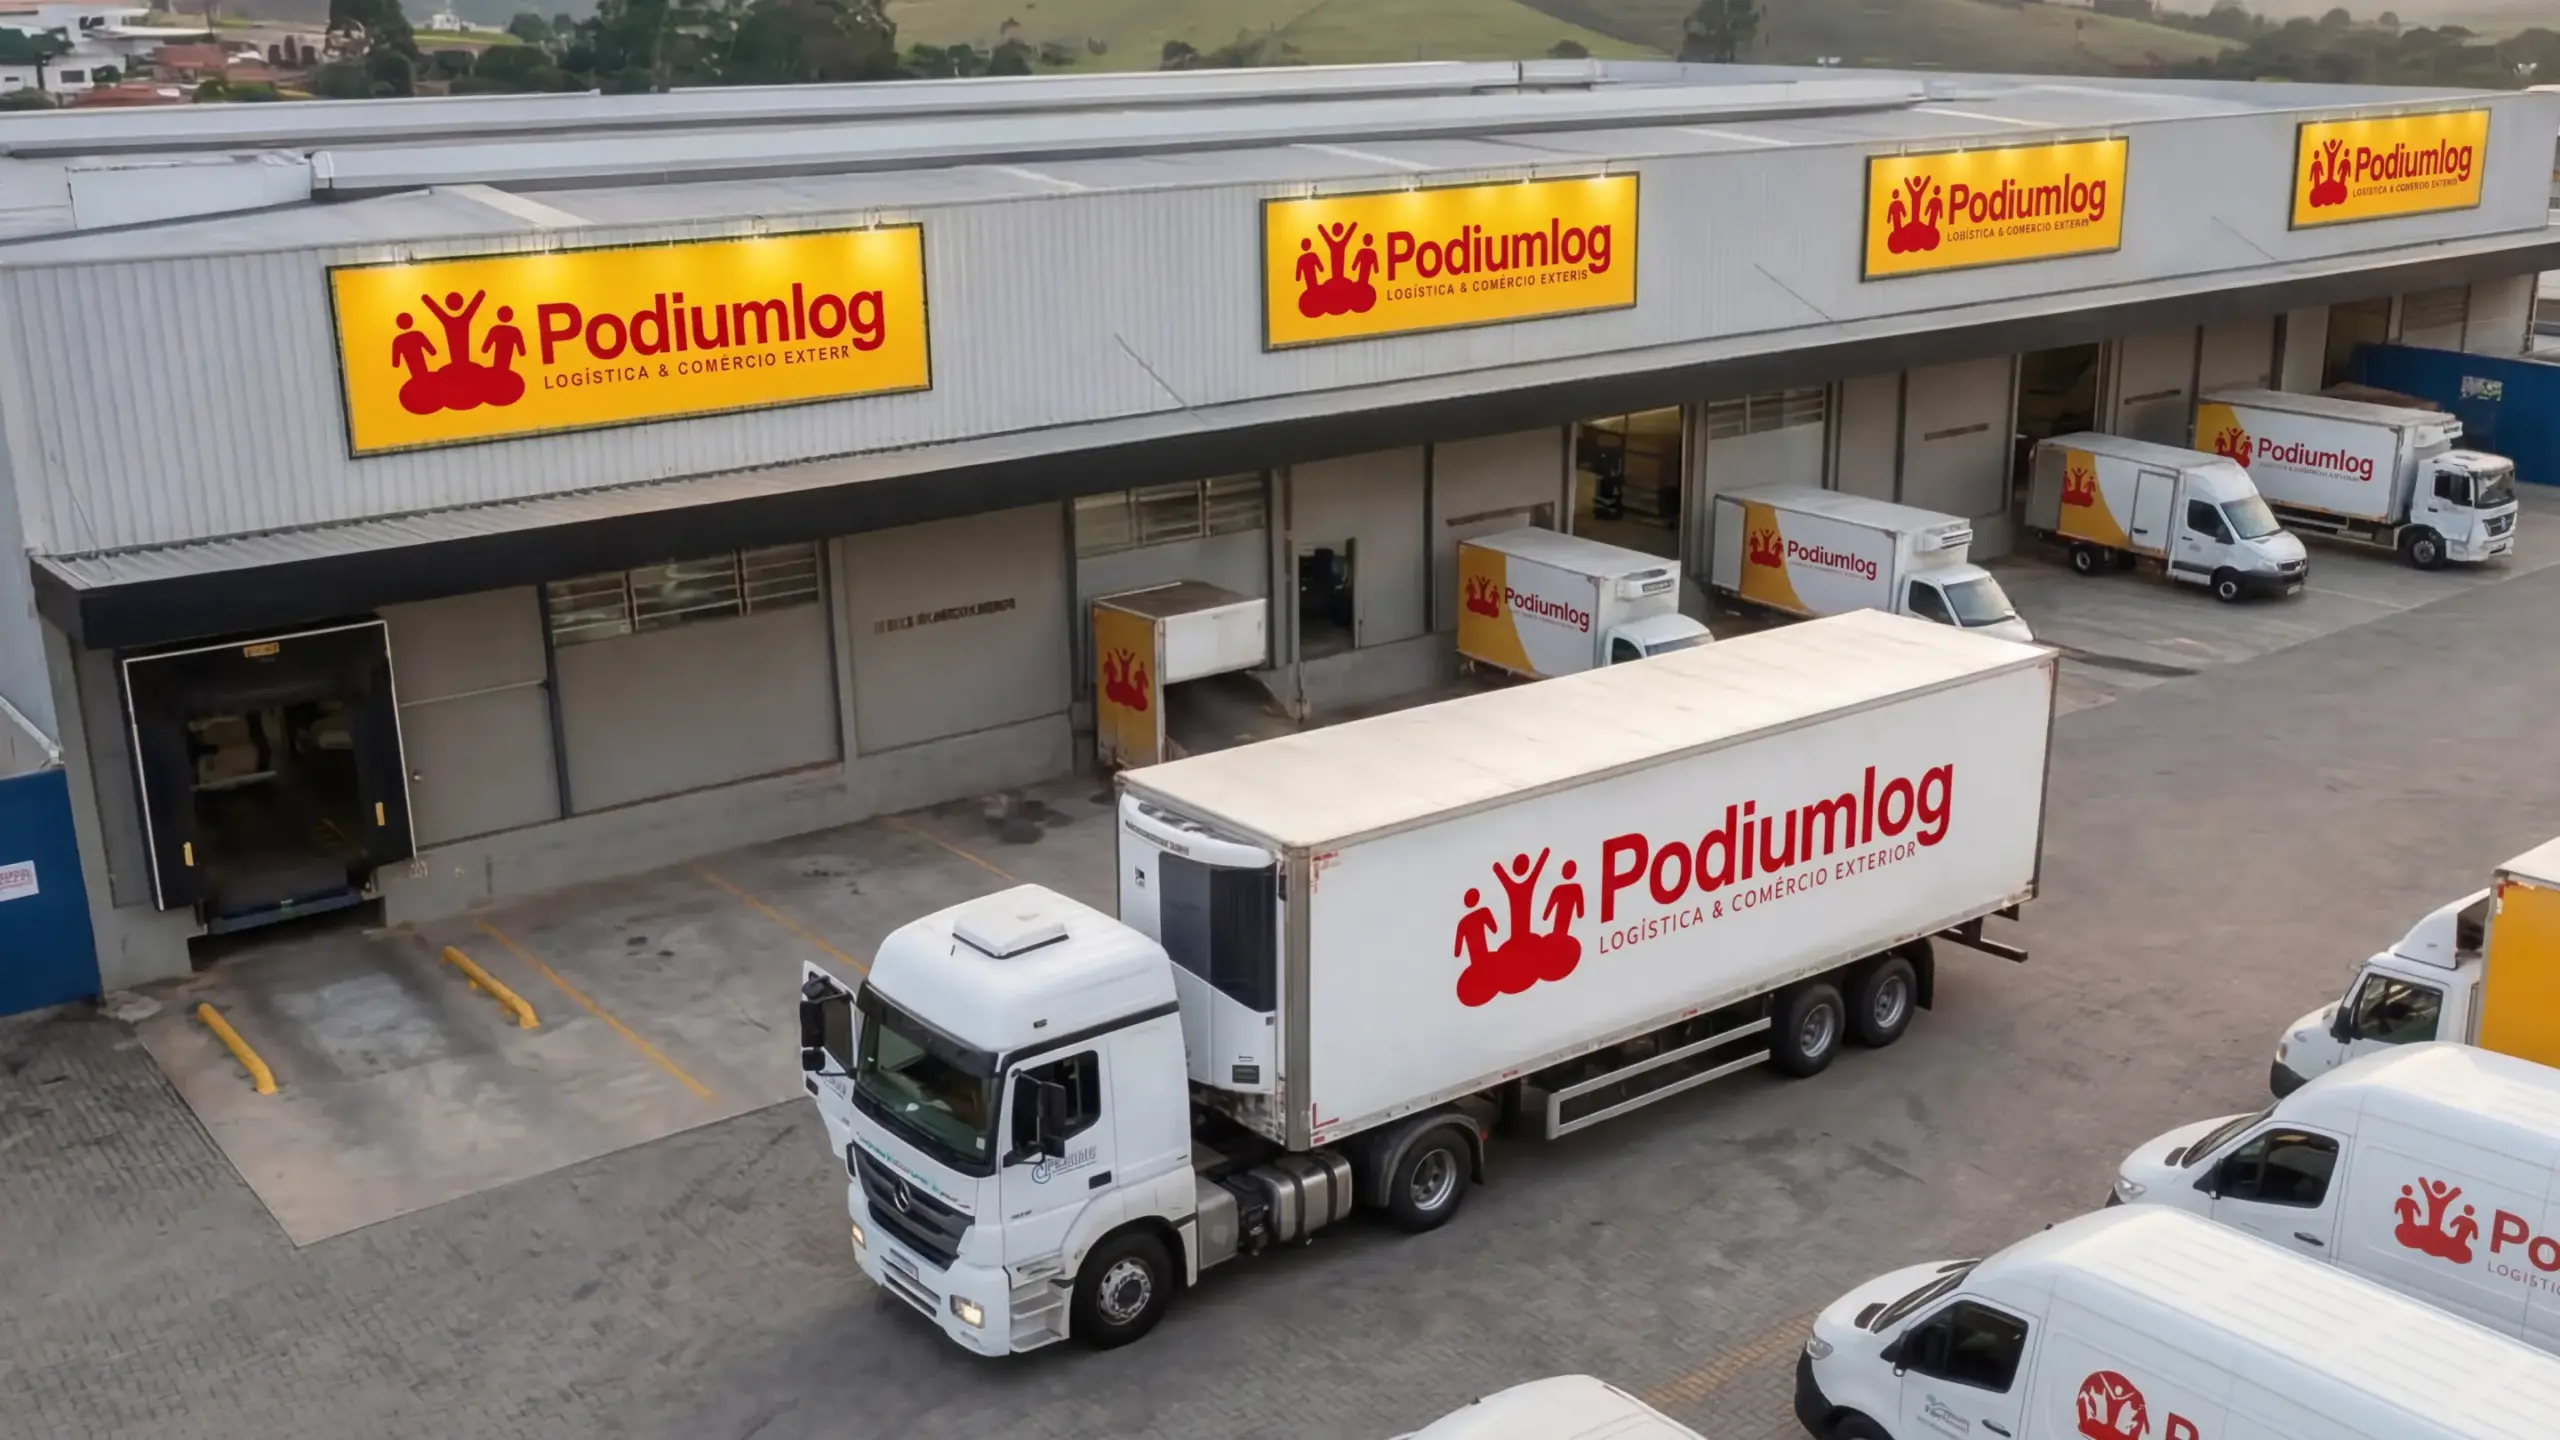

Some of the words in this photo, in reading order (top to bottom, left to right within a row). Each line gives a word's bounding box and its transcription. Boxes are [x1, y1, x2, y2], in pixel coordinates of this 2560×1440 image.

[2354, 138, 2473, 183] Podiumlog
[1948, 173, 2106, 226] Podiumlog
[1386, 217, 1611, 282] Podiumlog
[1460, 282, 1468, 293] &
[1472, 274, 1536, 292] COMÉRCIO
[537, 282, 886, 366] Podiumlog
[658, 363, 669, 377] &
[678, 353, 777, 376] COMÉRCIO
[2258, 437, 2374, 482] Podiumlog
[1787, 540, 1877, 581] Podiumlog
[1504, 587, 1590, 633] Podiumlog
[1600, 763, 1953, 924] Podiumlog
[1712, 899, 1724, 919] &
[1731, 867, 1828, 913] COMÉRCIO
[1835, 840, 1917, 881] EXTERIOR
[2490, 1209, 2560, 1272] Po
